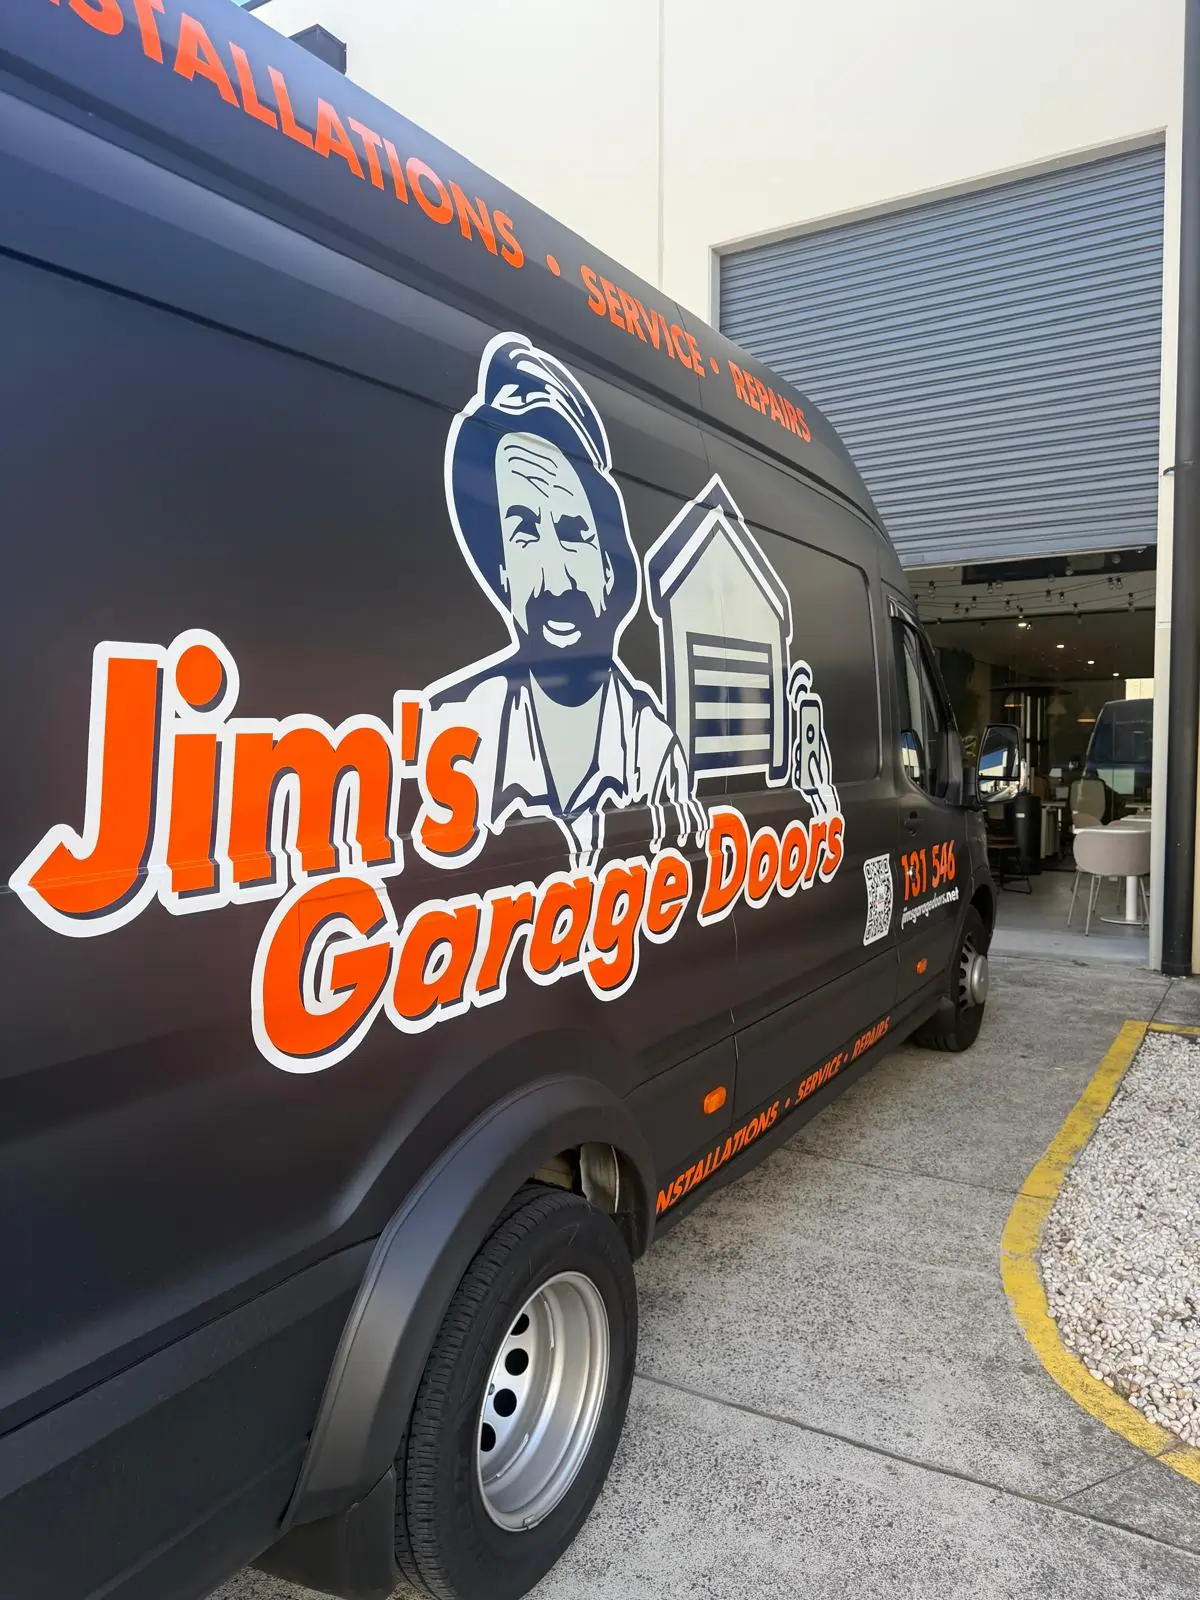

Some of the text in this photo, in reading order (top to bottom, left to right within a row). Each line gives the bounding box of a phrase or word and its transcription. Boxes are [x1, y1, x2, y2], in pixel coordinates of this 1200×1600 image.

[48, 0, 811, 443] TALLATIONS SERVICE REPAIRS
[18, 636, 485, 926] Jim's
[902, 839, 956, 900] 131 546
[256, 808, 845, 1064] Garage Doors
[794, 1052, 843, 1105] SERVICE
[851, 1015, 891, 1062] REPAIRS
